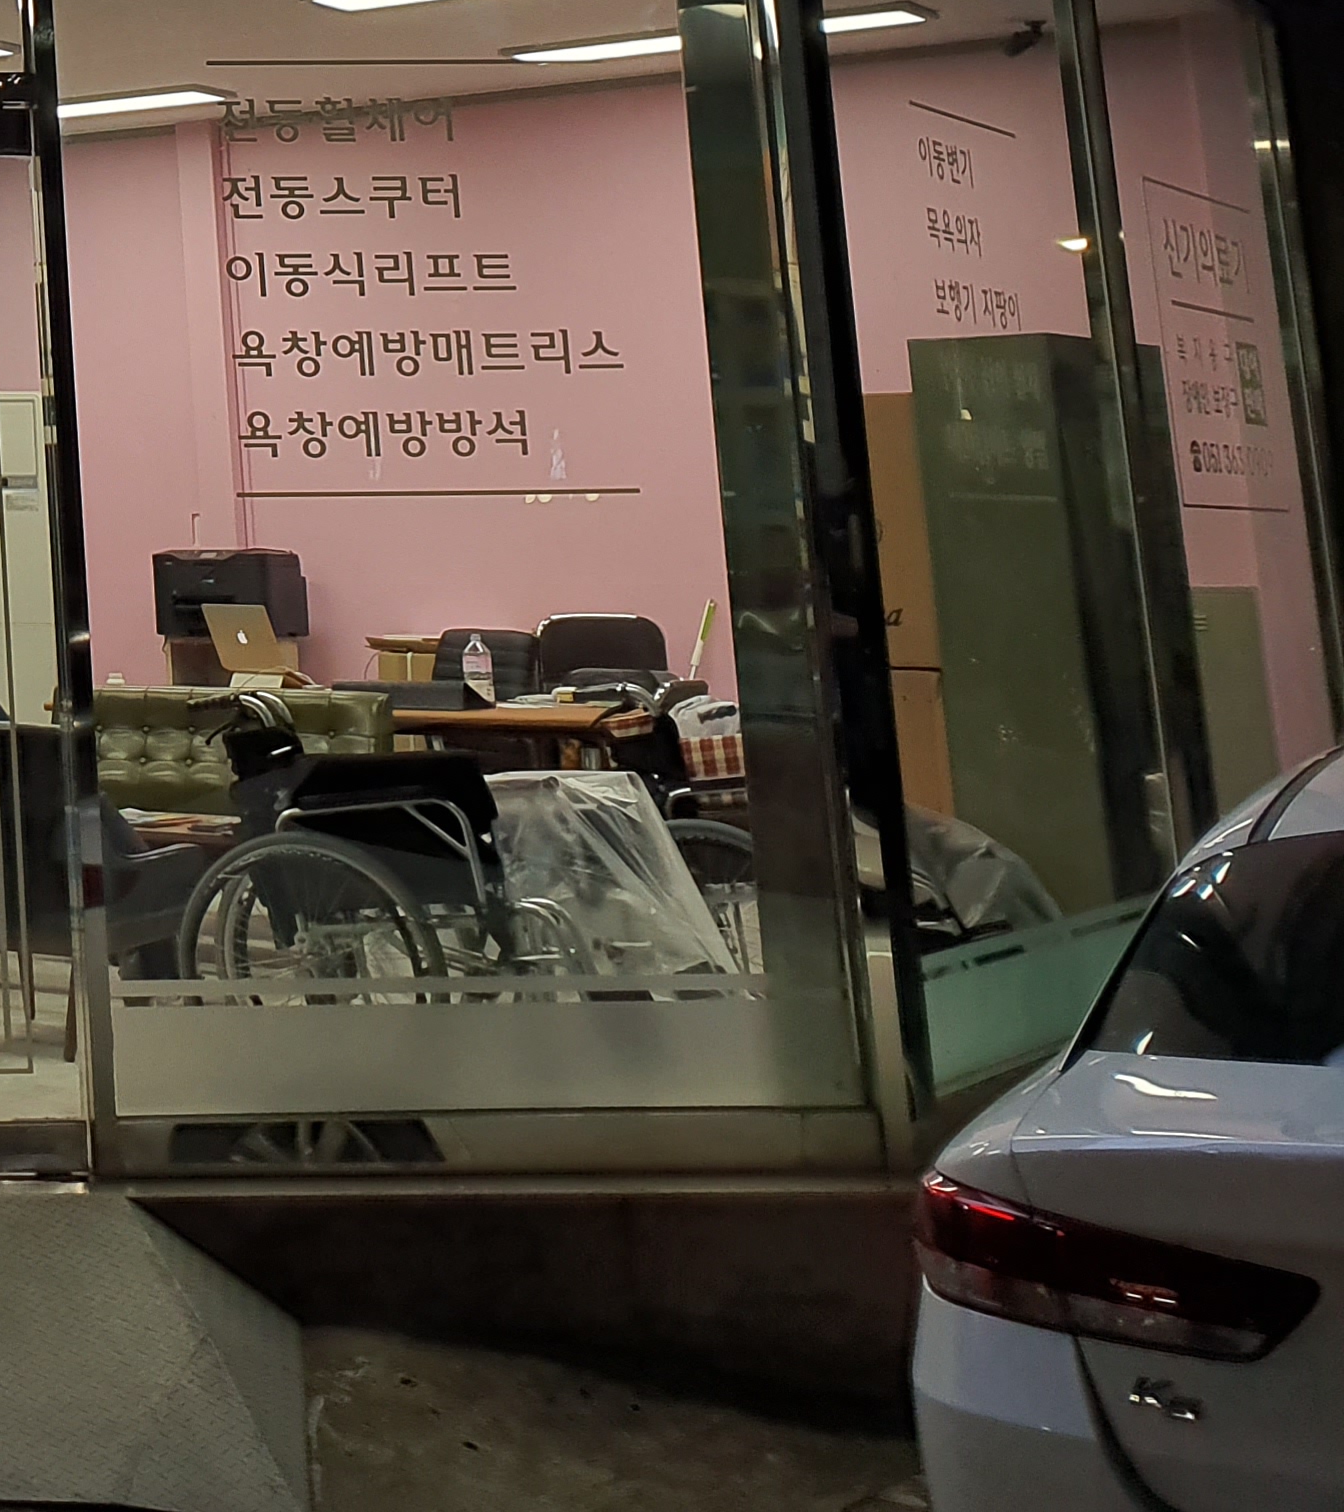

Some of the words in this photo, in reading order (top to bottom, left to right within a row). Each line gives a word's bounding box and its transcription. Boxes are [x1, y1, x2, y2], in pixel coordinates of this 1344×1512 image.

[216, 96, 457, 143] 전동휠체어
[917, 135, 975, 189] 이동변기
[221, 173, 462, 220] 전동스쿠터
[925, 206, 983, 259] 목욕의자
[1162, 216, 1252, 296] 신기의료기
[225, 251, 518, 298] 이동식리프트
[933, 278, 978, 325] 보행기
[980, 286, 1023, 332] 지팡이
[231, 329, 625, 378] 욕창예방매트리스
[237, 409, 530, 459] 욕창예방방석
